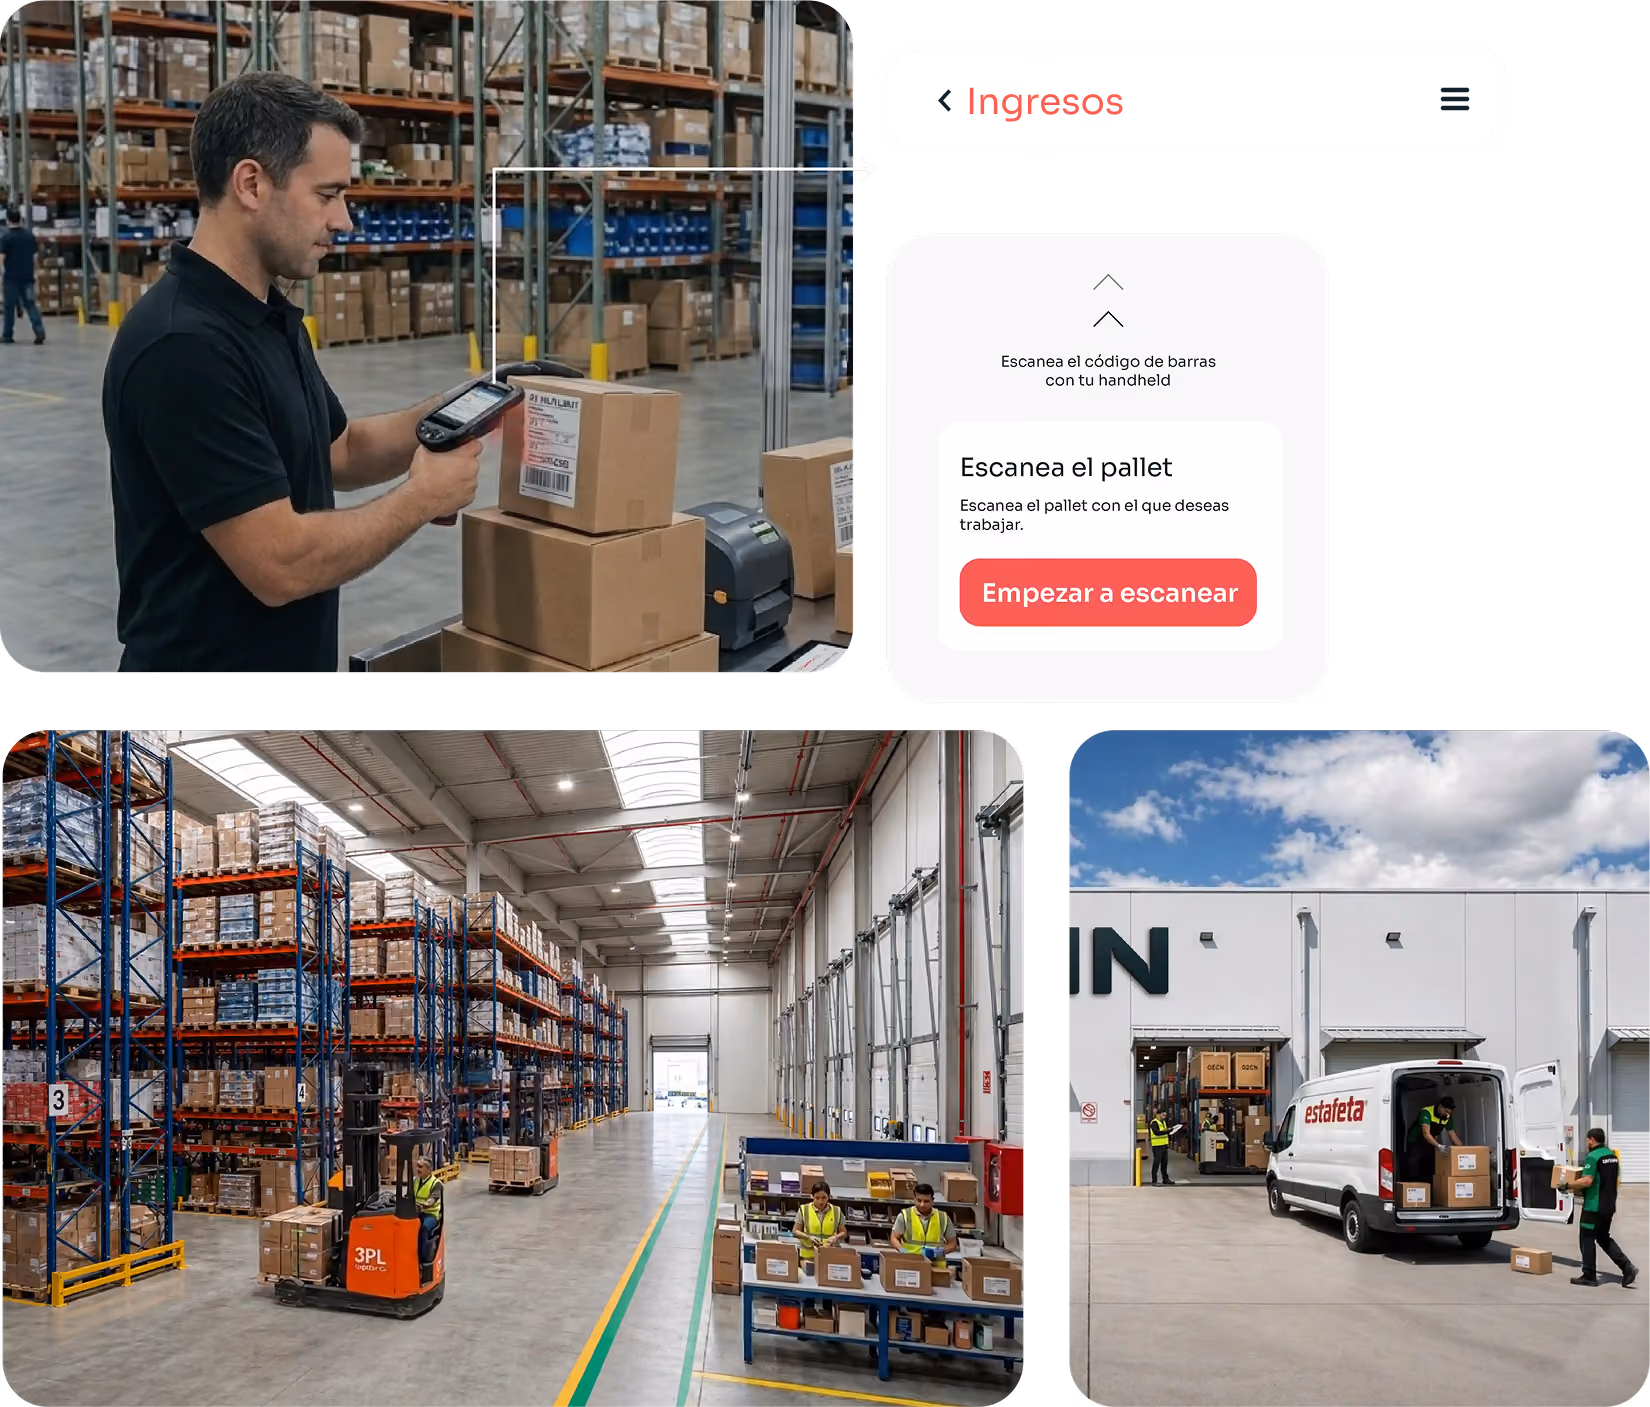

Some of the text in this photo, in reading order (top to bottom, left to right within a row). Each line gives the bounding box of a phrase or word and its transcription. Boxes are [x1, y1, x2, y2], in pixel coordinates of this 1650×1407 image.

[53, 1089, 65, 1110] 3
[299, 1085, 305, 1099] 4
[1305, 1096, 1365, 1124] estafeta
[354, 1246, 387, 1265] 3PL
